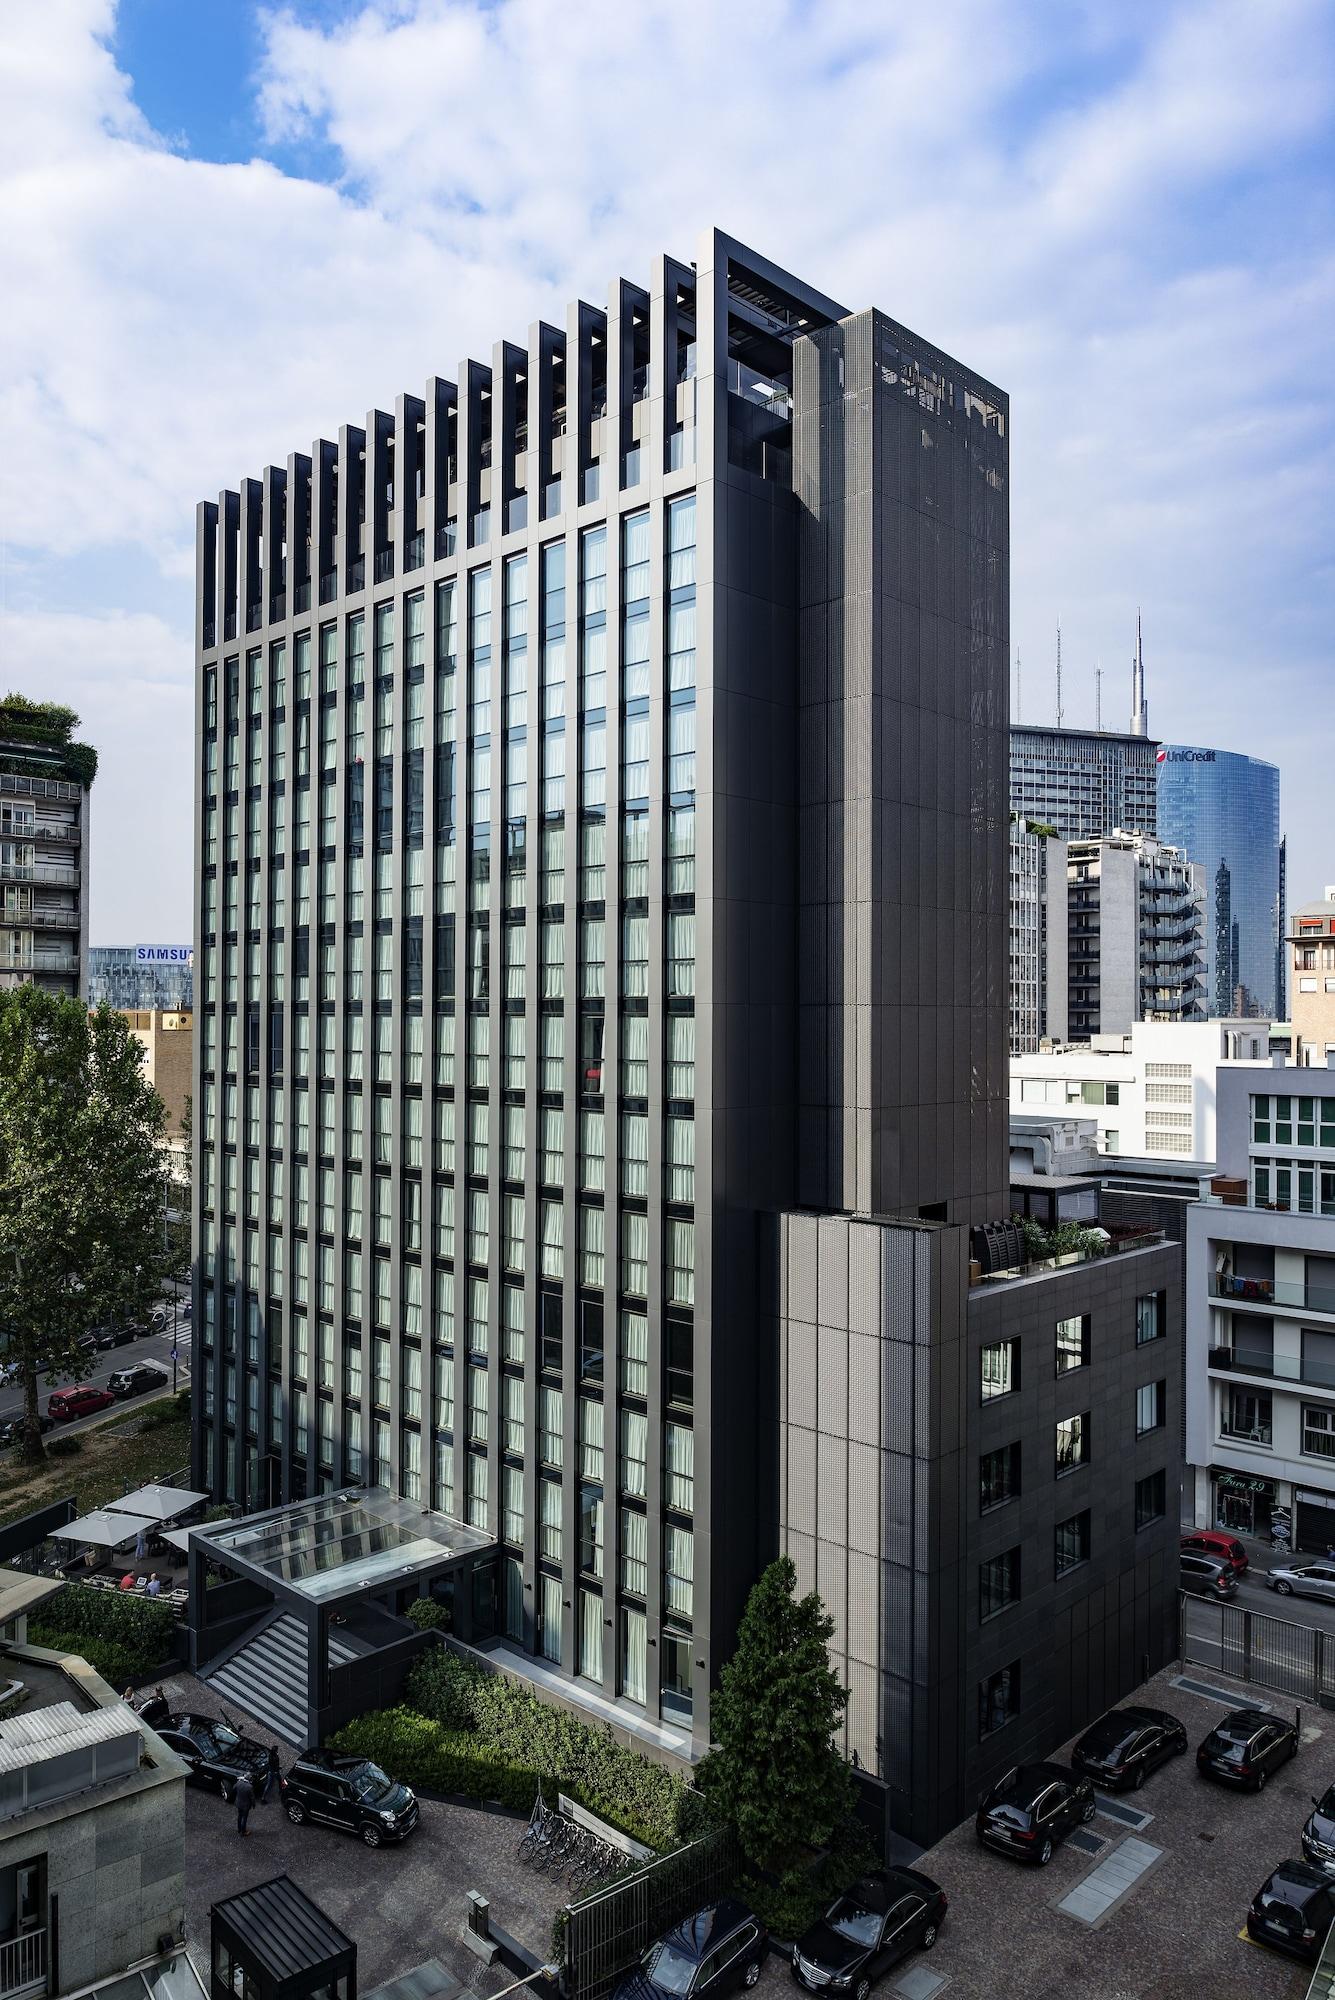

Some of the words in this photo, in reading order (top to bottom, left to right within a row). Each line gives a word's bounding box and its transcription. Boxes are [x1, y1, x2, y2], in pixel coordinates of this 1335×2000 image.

[1167, 750, 1216, 762] UniCredit
[138, 948, 194, 960] SAMSU
[1248, 1480, 1265, 1492] 29
